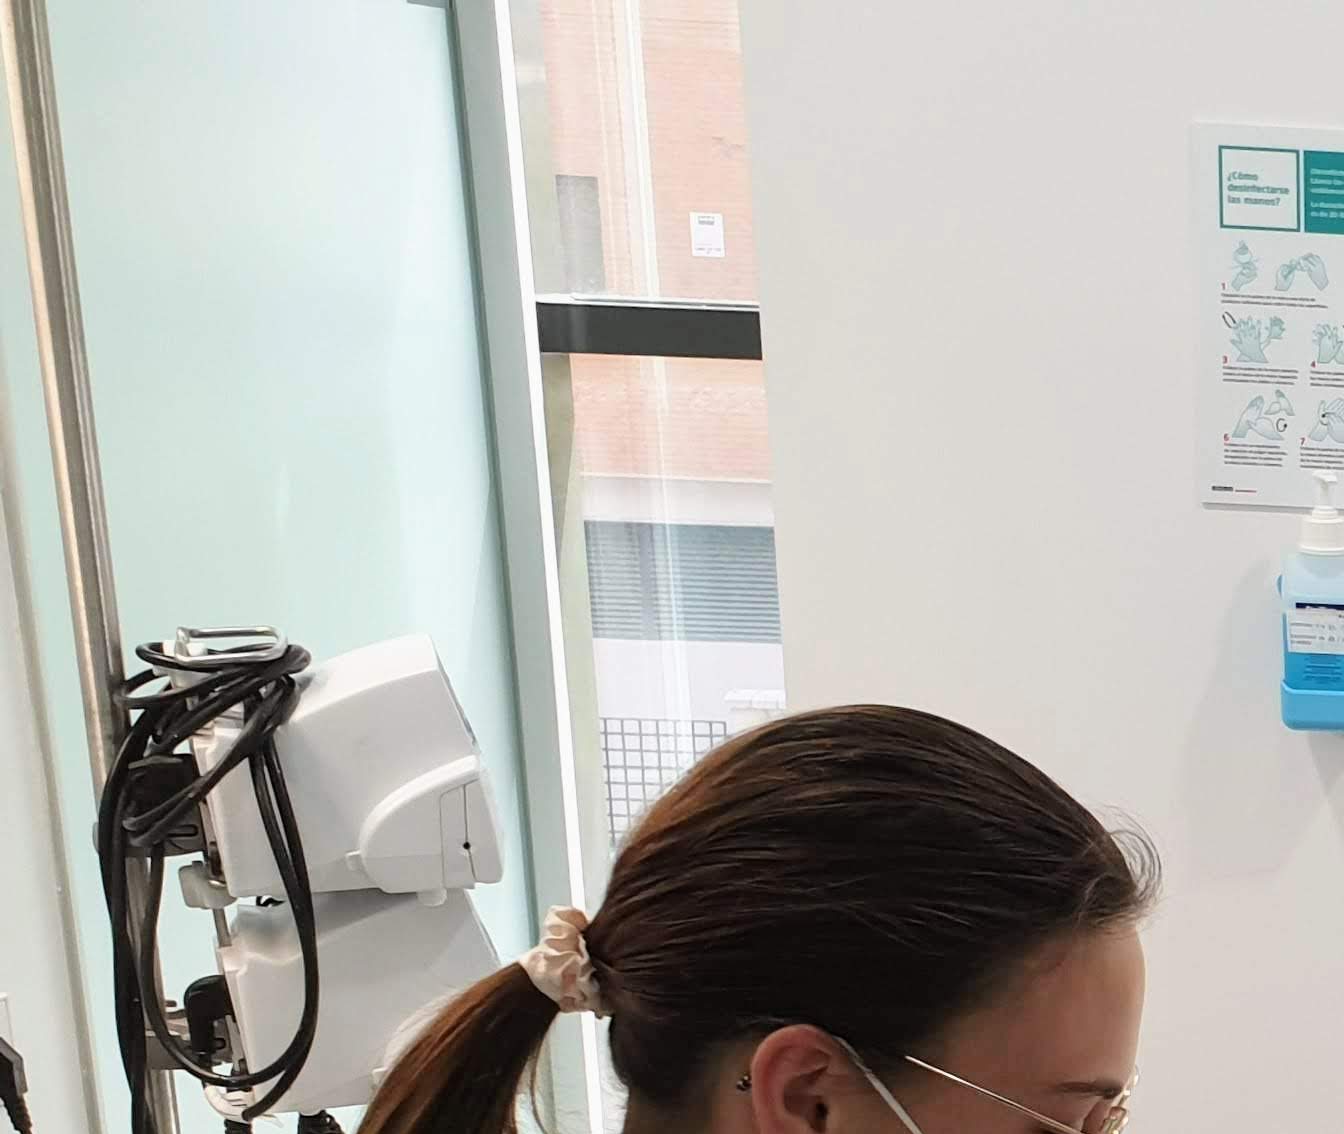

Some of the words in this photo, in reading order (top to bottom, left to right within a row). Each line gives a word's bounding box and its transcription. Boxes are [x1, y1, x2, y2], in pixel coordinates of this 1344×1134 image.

[1227, 171, 1258, 182] ¿Cómo
[1227, 183, 1290, 195] desinfectarse
[1227, 194, 1241, 204] las
[1243, 197, 1281, 206] manos?
[1222, 356, 1228, 364] 3
[1223, 433, 1229, 441] 6
